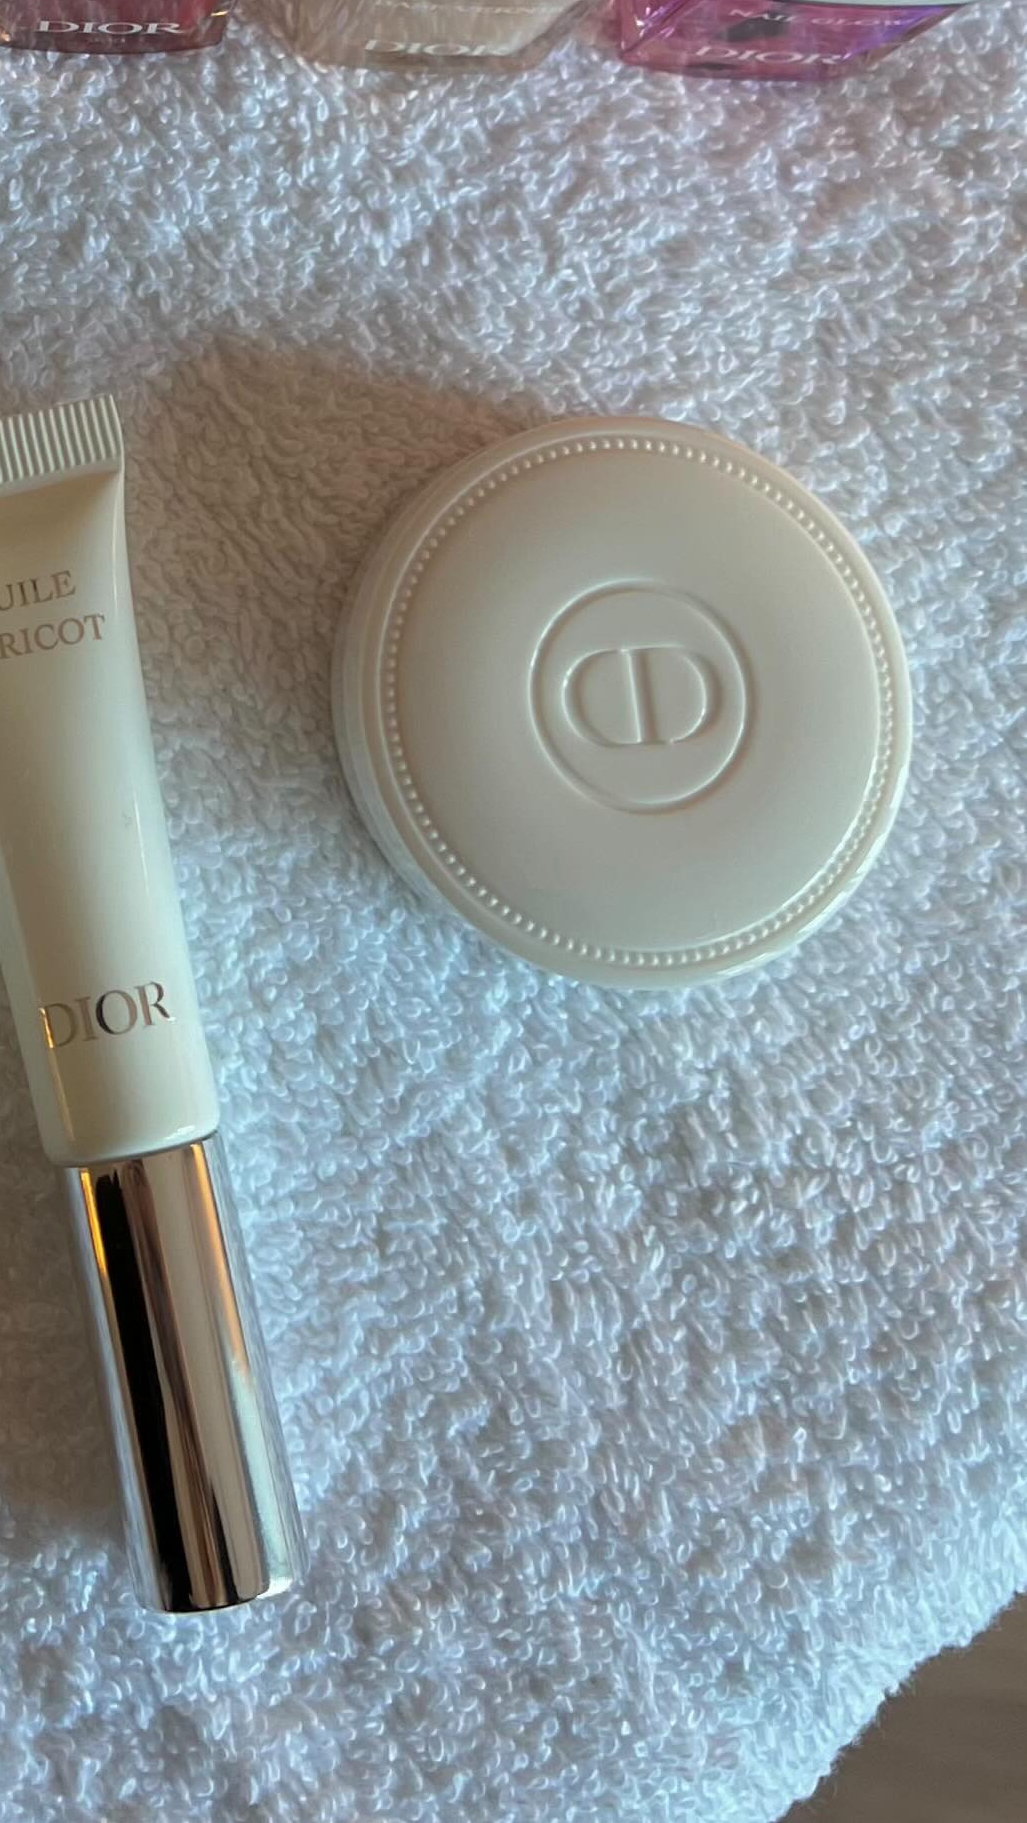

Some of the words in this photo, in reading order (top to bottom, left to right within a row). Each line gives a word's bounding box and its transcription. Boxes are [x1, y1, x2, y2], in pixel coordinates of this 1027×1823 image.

[36, 20, 191, 36] DIOR
[695, 45, 843, 66] DIOR
[38, 980, 177, 1049] DIOR
